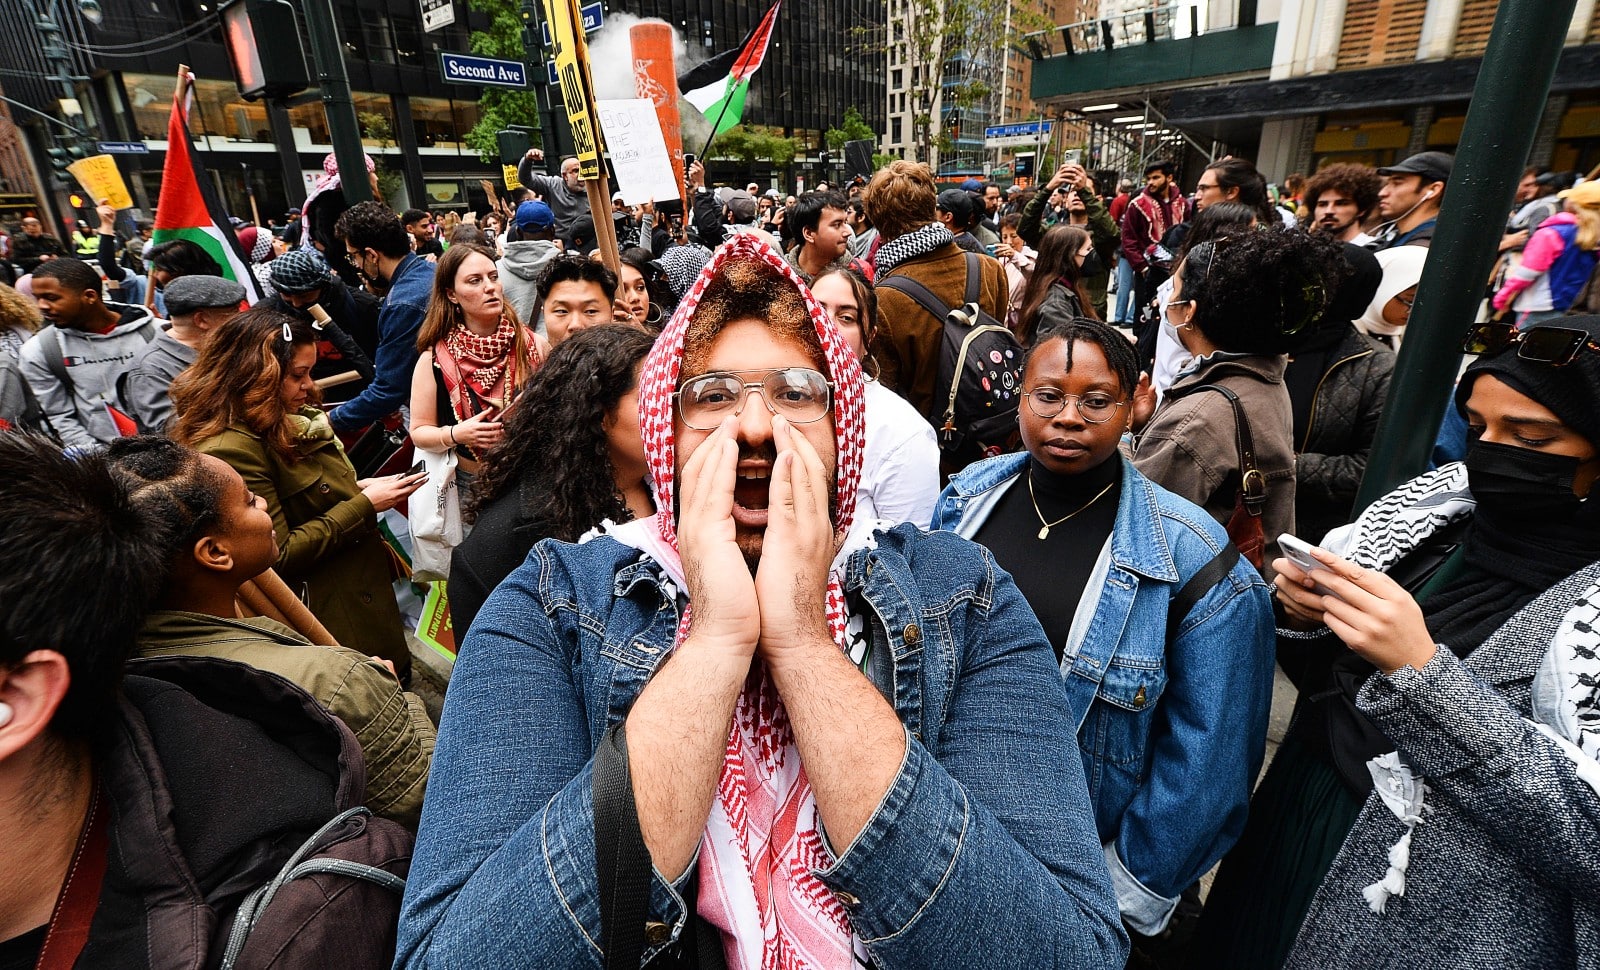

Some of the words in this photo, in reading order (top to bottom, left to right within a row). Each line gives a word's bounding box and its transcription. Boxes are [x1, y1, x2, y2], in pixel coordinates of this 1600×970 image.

[448, 60, 496, 80] Second
[498, 66, 520, 82] Ave
[561, 62, 583, 116] AID
[62, 351, 134, 367] Champi
